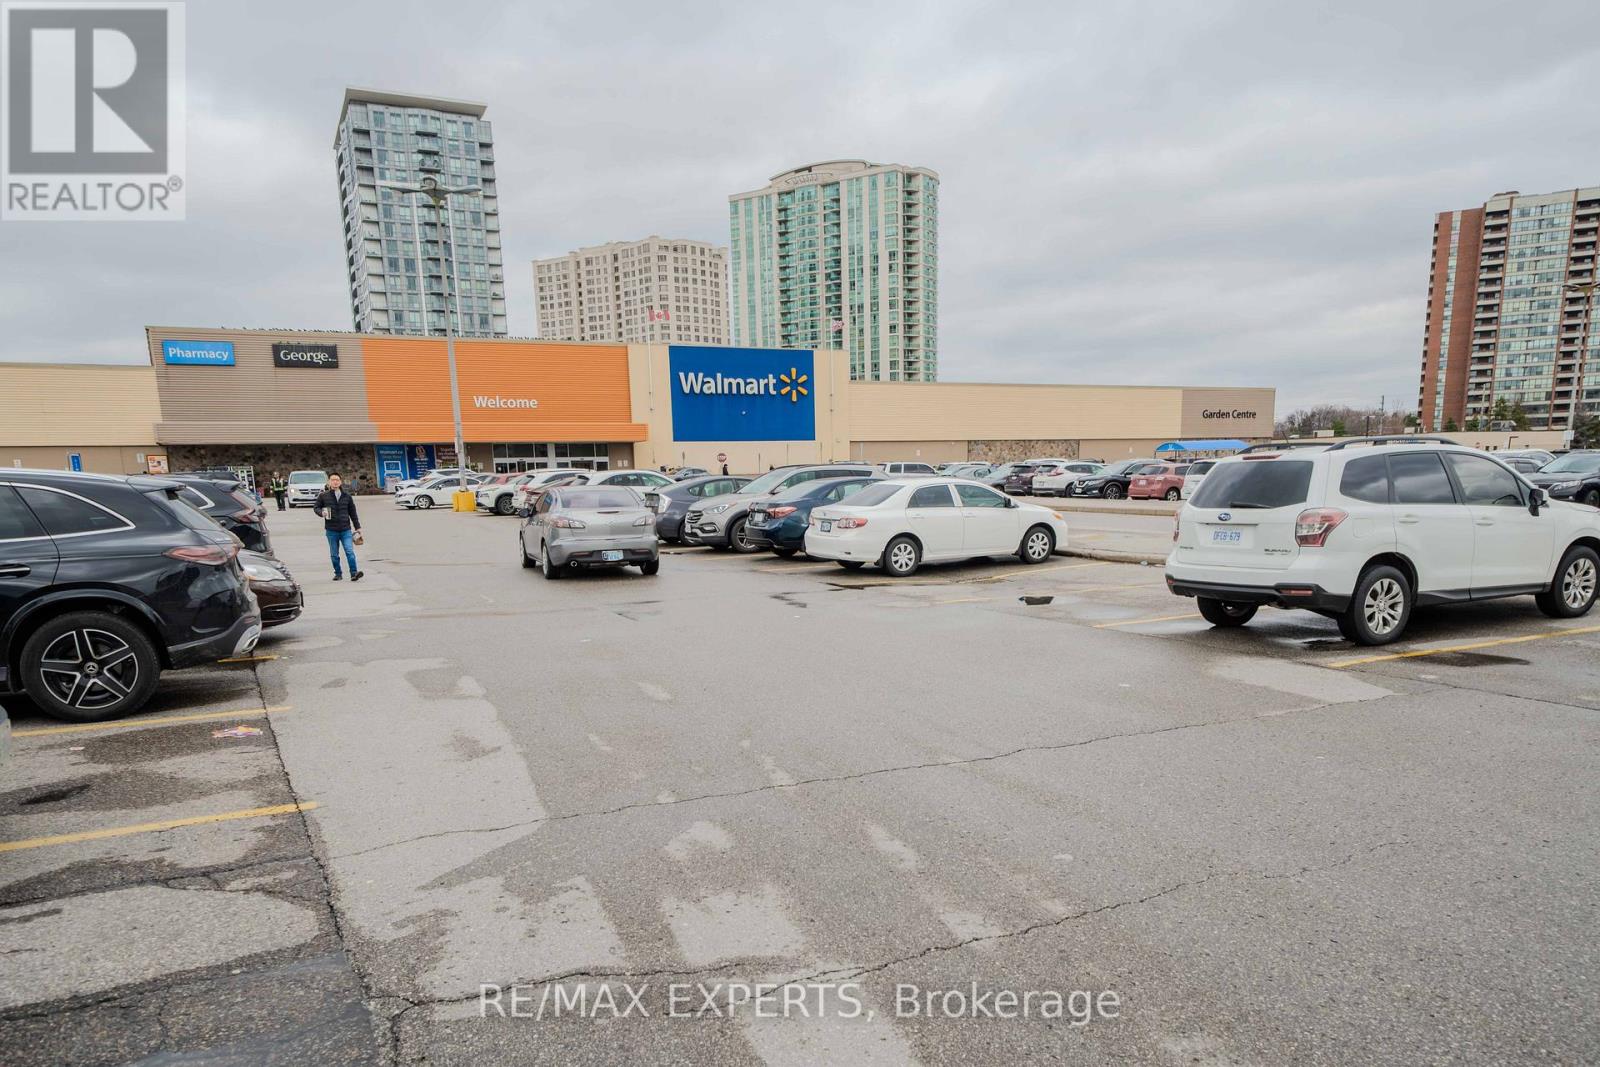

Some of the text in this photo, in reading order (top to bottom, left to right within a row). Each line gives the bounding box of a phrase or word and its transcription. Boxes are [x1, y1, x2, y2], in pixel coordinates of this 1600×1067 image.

[168, 347, 229, 361] Pharmacy
[678, 372, 777, 395] Walmart
[473, 395, 538, 409] Welcome
[1202, 409, 1257, 419] Garden Centre
